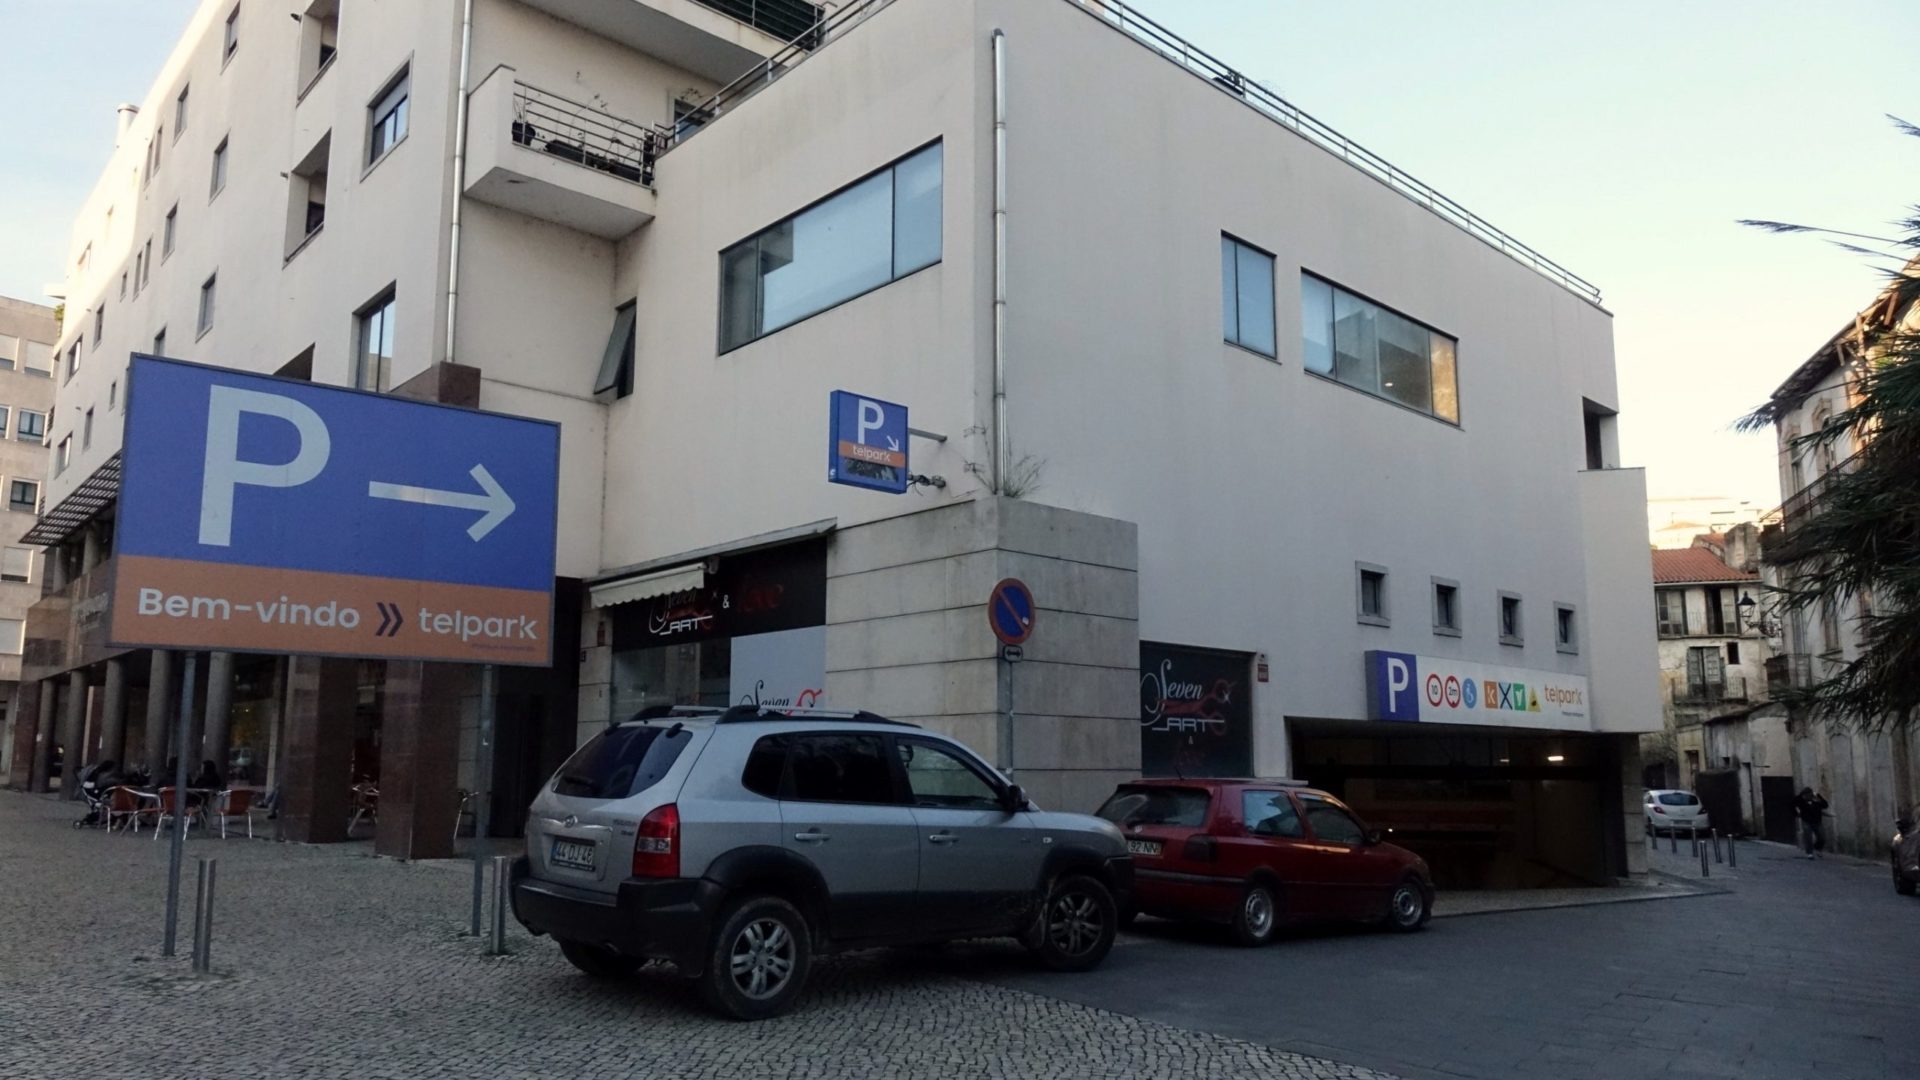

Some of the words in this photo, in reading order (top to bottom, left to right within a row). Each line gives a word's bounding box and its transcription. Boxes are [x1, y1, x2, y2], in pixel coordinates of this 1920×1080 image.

[858, 398, 885, 445] P
[198, 384, 332, 547] P
[852, 445, 891, 463] telpark
[137, 587, 361, 630] Bem-vindo
[418, 606, 538, 643] telpark
[722, 594, 731, 609] &
[1145, 659, 1203, 717] Seven
[1387, 658, 1410, 713] P
[1544, 684, 1583, 706] telpark
[1155, 717, 1221, 733] ART
